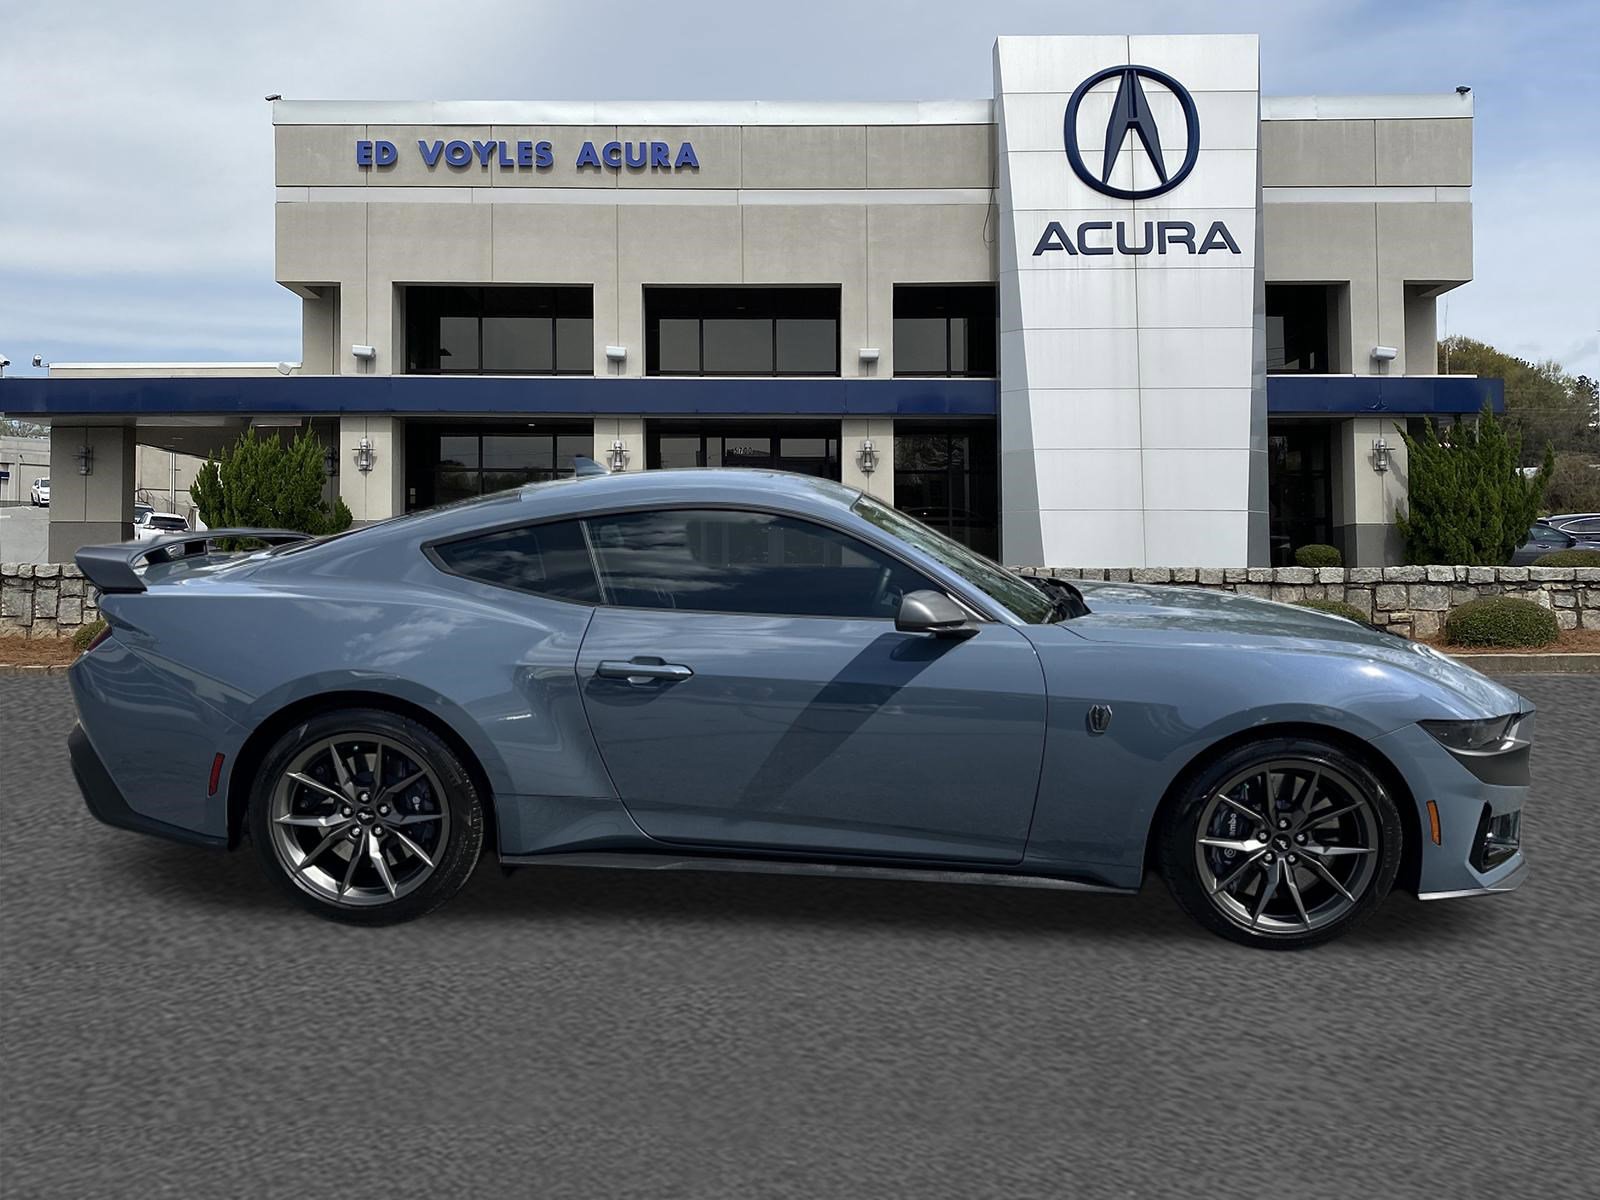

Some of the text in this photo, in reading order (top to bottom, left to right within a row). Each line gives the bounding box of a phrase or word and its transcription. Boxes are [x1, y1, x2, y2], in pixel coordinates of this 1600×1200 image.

[356, 140, 700, 169] ED VOYLES ACURA
[1032, 221, 1242, 256] ACURA
